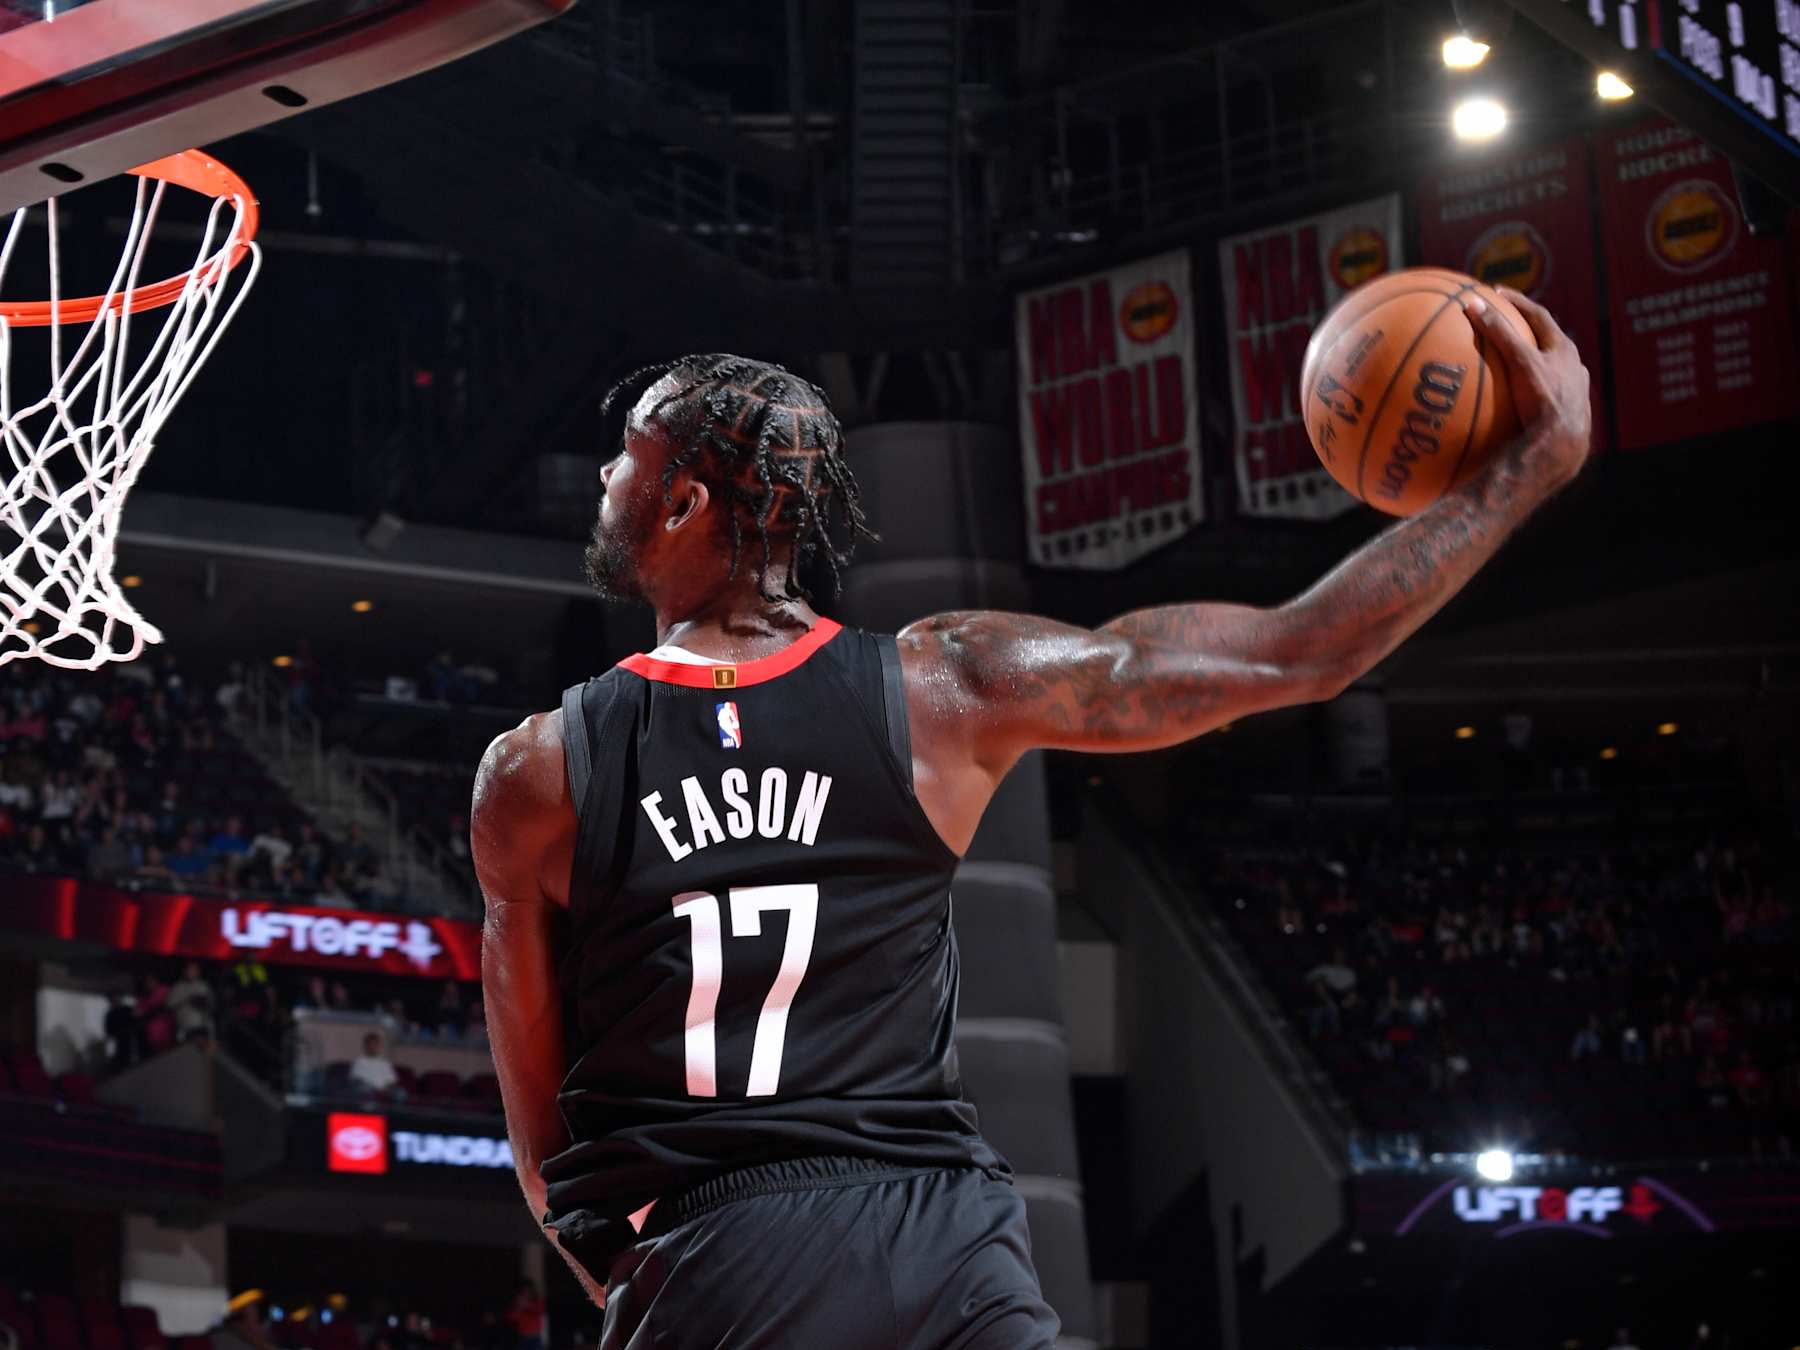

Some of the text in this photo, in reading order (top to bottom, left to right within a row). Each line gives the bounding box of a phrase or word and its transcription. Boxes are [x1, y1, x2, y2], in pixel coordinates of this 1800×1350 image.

[1028, 278, 1117, 383] NBA
[1030, 354, 1186, 477] WORLD
[1375, 361, 1467, 498] Wilson
[640, 767, 833, 863] EASON
[221, 907, 399, 958] LIFTOFF
[671, 883, 820, 1098] 17
[391, 1131, 515, 1169] TUNDRA
